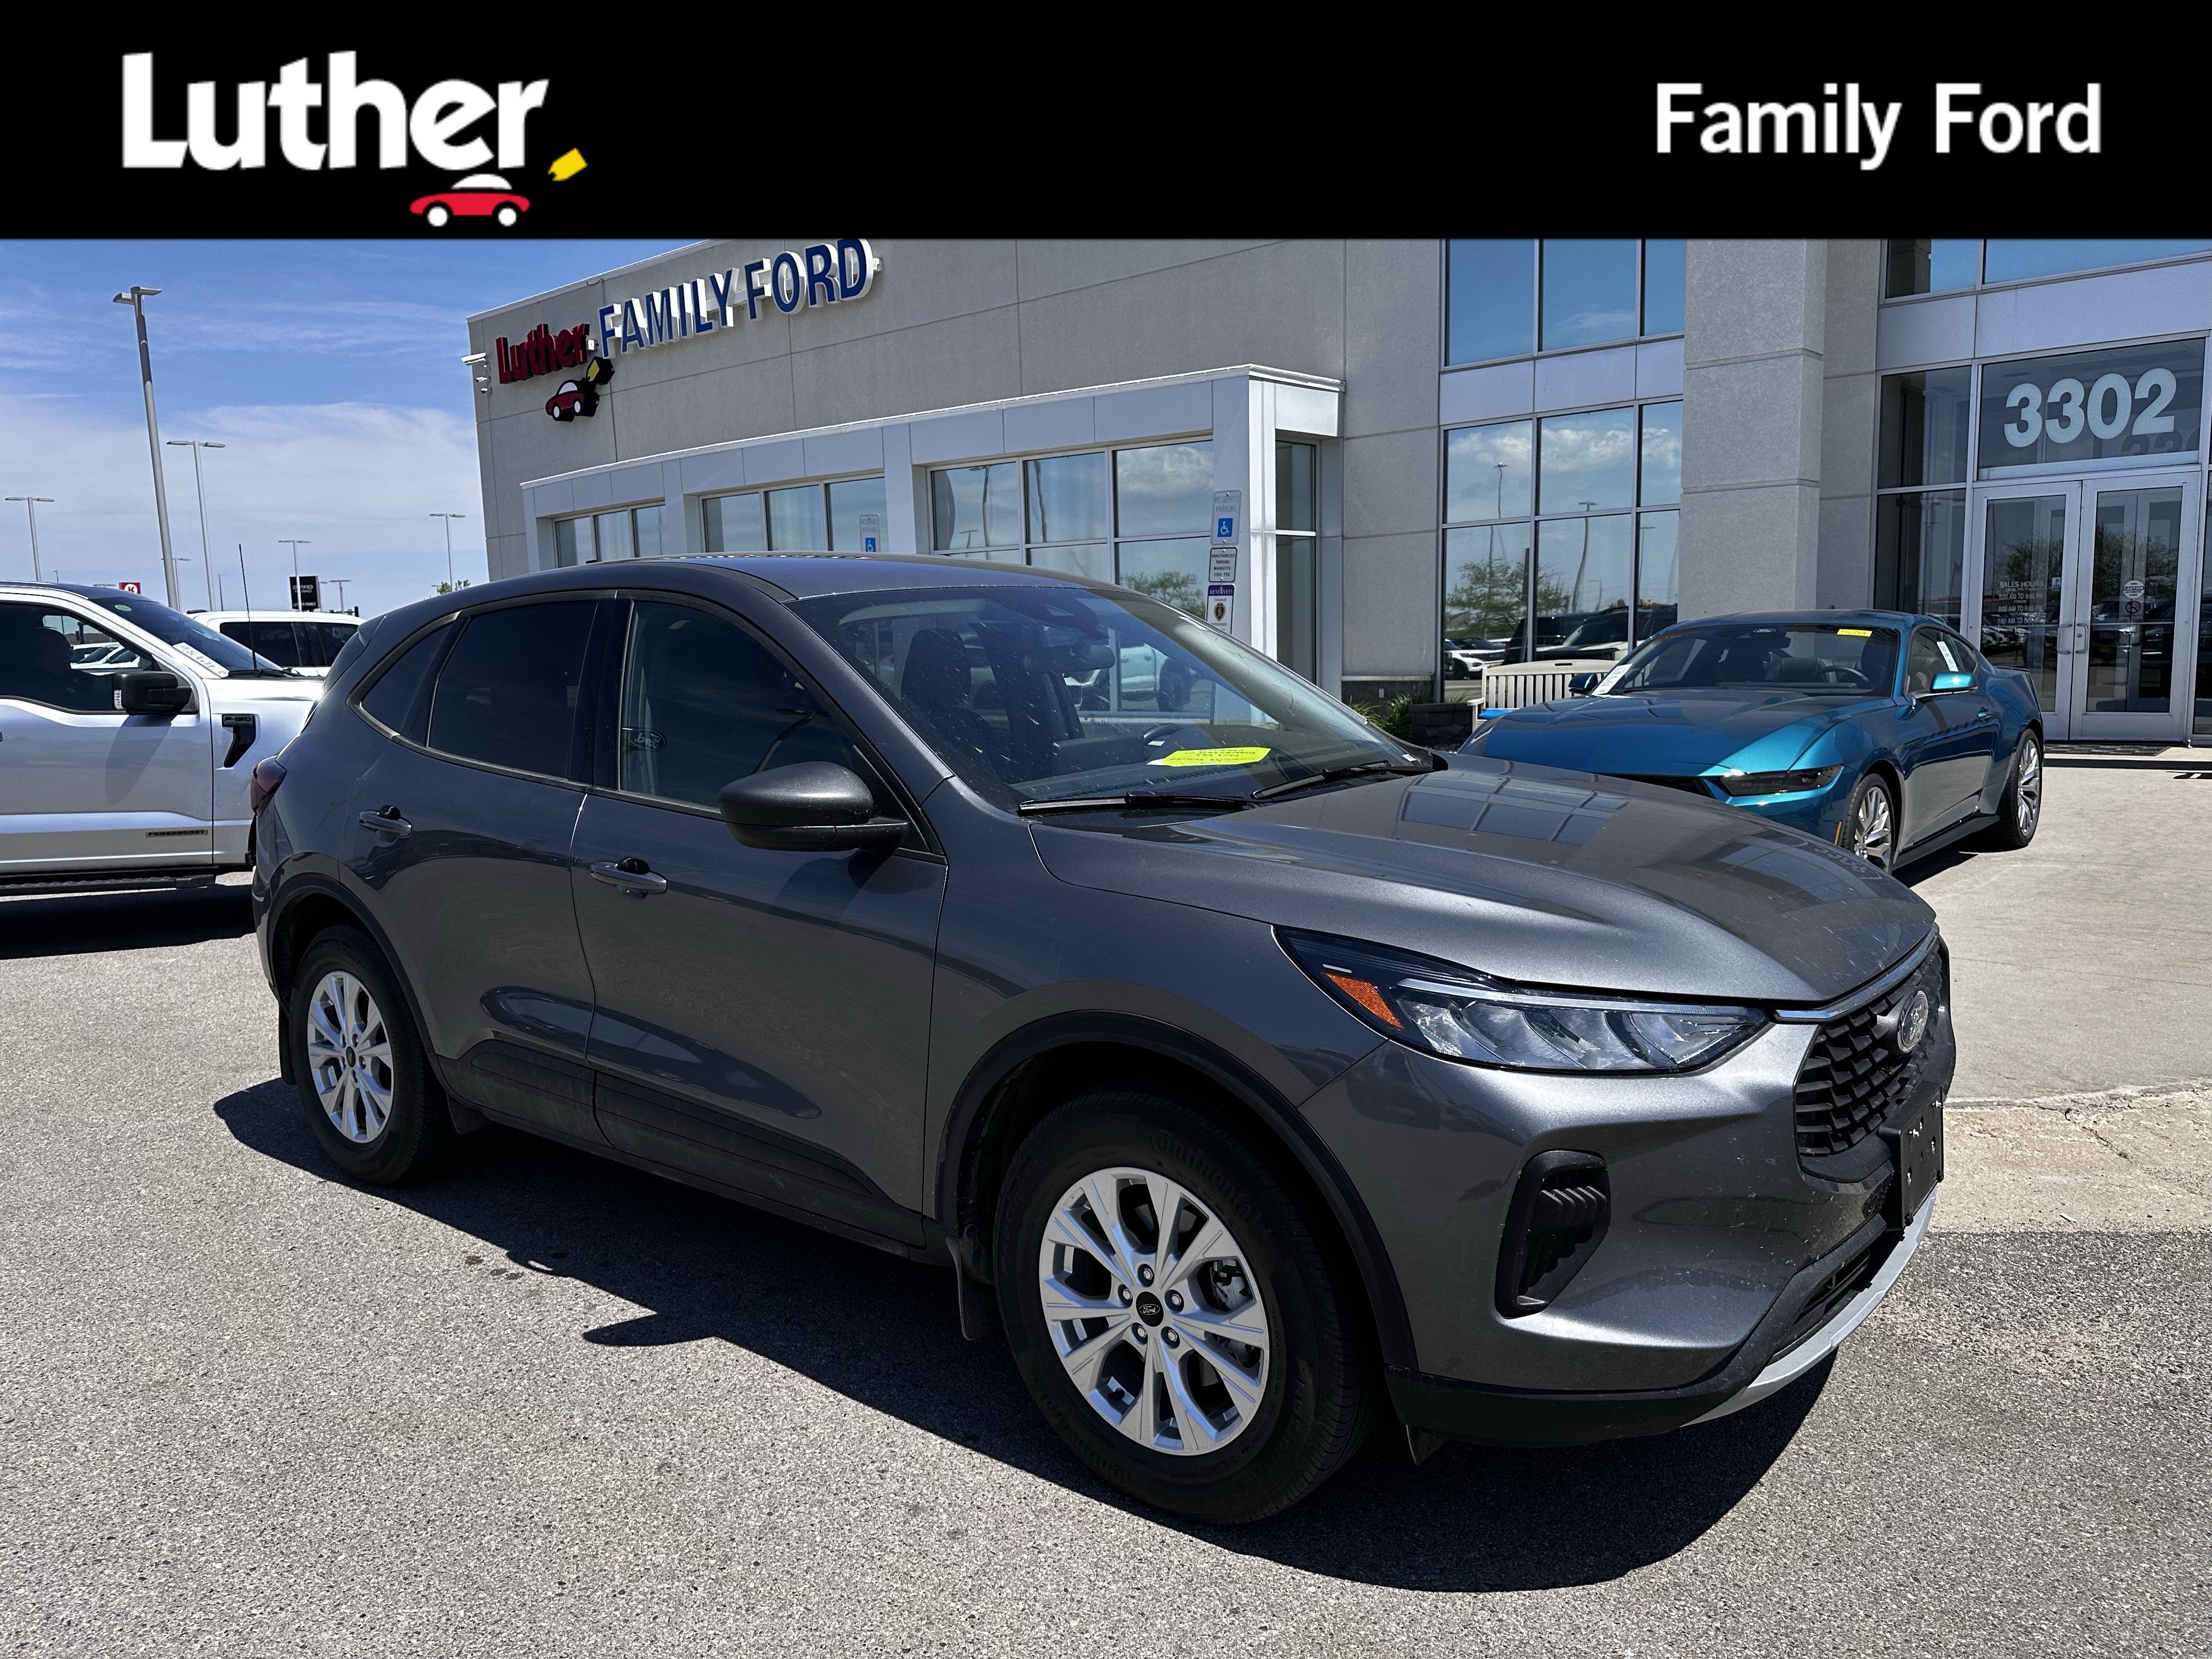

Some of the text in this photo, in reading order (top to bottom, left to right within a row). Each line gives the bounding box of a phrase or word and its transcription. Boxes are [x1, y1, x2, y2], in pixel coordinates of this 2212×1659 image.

[597, 238, 873, 359] FAMILY FORD
[495, 323, 590, 384] Luther
[2004, 368, 2177, 448] 3302
[2021, 580, 2044, 588] HOURS
[1143, 1305, 1156, 1313] Ford
